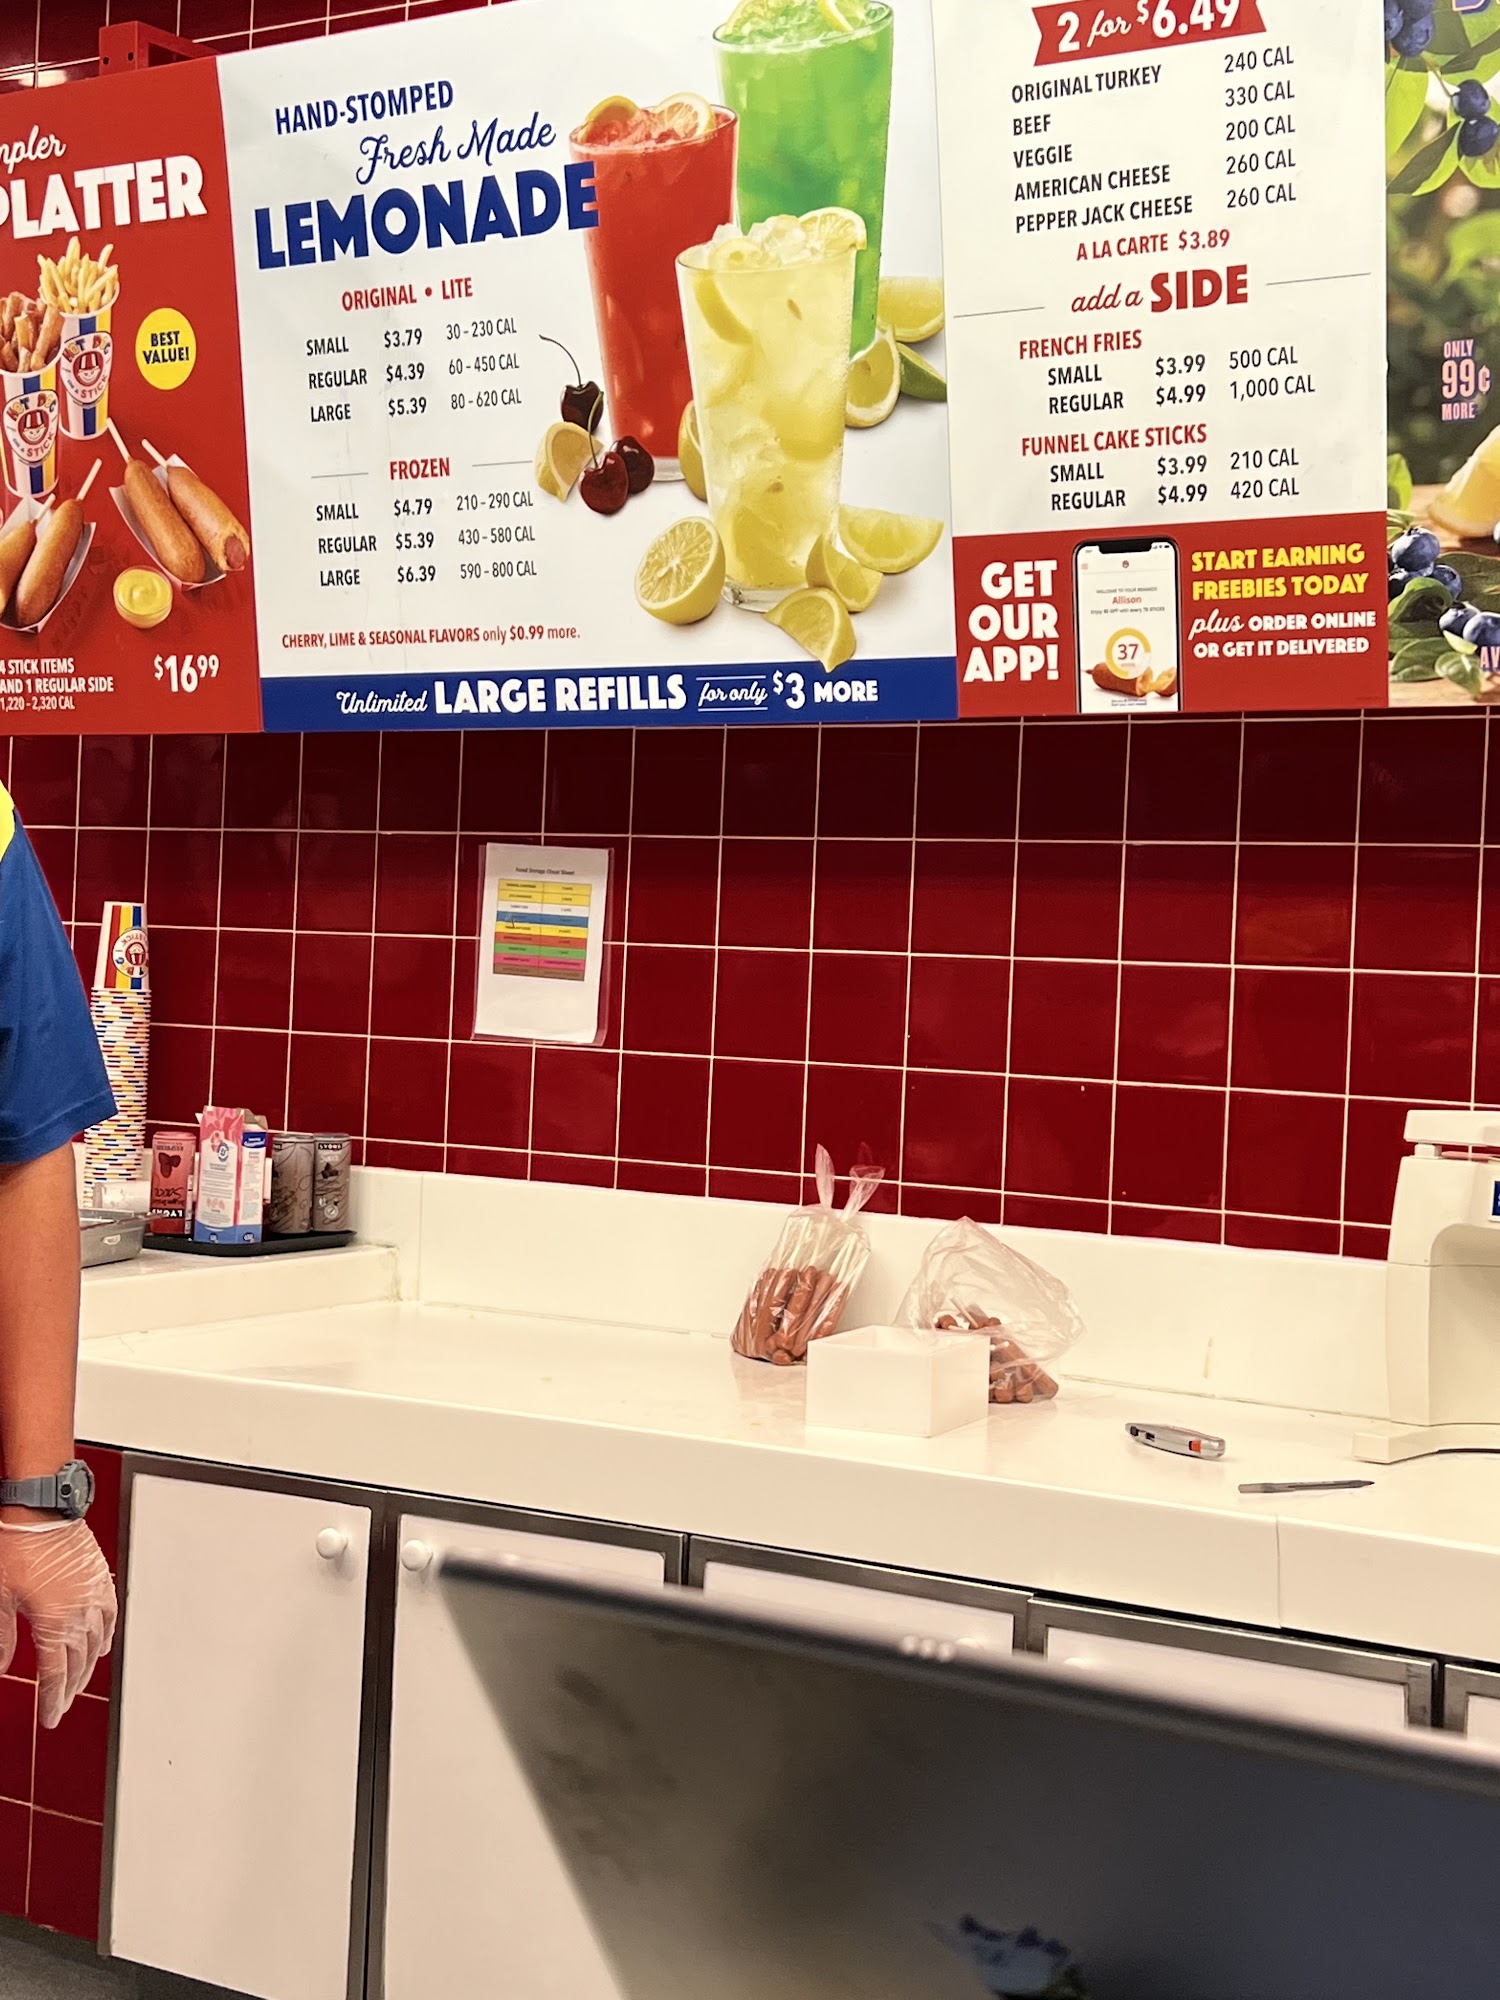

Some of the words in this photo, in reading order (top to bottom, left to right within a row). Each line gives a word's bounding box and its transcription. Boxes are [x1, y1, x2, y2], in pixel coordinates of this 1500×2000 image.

[1057, 11, 1080, 53] 2
[1087, 10, 1131, 47] for
[1137, 0, 1239, 38] $6.49
[1224, 51, 1257, 73] 240
[1263, 45, 1294, 67] CAL
[1012, 75, 1092, 103] ORIGINAL
[1095, 64, 1161, 91] TURKEY
[1225, 85, 1258, 107] 330
[1264, 80, 1295, 102] CAL
[276, 81, 453, 135] HAND-STOMPED
[1013, 114, 1051, 136] BEEF
[1226, 119, 1258, 141] 200
[1264, 114, 1295, 136] CAL
[356, 125, 451, 185] Fresh
[457, 111, 556, 166] Made
[1013, 144, 1072, 168] VEGGIE
[1226, 153, 1259, 175] 260
[1265, 149, 1296, 170] CAL
[1015, 173, 1102, 201] AMERICAN
[1108, 164, 1170, 190] CHEESE
[1227, 187, 1259, 208] 260
[1265, 183, 1296, 204] CAL
[255, 161, 599, 270] LEMONADE
[1016, 205, 1077, 233] PEPPER
[1081, 203, 1125, 226] JACK
[1130, 195, 1192, 220] CHEESE
[1076, 243, 1088, 261] A
[1093, 240, 1112, 259] LA
[1117, 233, 1168, 256] CARTE
[1179, 229, 1230, 251] $3.89
[342, 284, 417, 311] ORIGINAL
[442, 277, 473, 300] LITE
[1071, 283, 1121, 313] add
[1125, 284, 1143, 307] a
[1151, 264, 1248, 313] SIDE
[151, 330, 180, 347] BEST
[384, 328, 422, 349] $3.79
[446, 323, 461, 340] 30
[471, 320, 493, 337] 230
[496, 318, 517, 335] CAL
[142, 346, 189, 364] VALUE!
[306, 336, 349, 356] SMALL
[1020, 335, 1087, 360] FRENCH
[1094, 329, 1142, 352] FRIES
[1444, 339, 1474, 358] ONLY
[449, 358, 463, 375] 60
[474, 355, 496, 372] 450
[499, 353, 520, 370] CAL
[1155, 354, 1205, 377] $3.99
[1229, 349, 1261, 370] 500
[1267, 346, 1298, 366] CAL
[309, 368, 367, 389] REGULAR
[386, 362, 424, 383] $4.39
[1048, 364, 1102, 386] SMALL
[1442, 359, 1490, 399] 99¢
[1156, 384, 1206, 406] $4.99
[1230, 377, 1278, 401] 1,000
[1284, 375, 1315, 394] CAL
[388, 397, 427, 417] $5.39
[451, 393, 465, 410] 80
[476, 390, 498, 407] 620
[501, 389, 522, 405] CAL
[1049, 391, 1124, 414] REGULAR
[311, 404, 351, 422] LARGE
[1442, 402, 1475, 421] MORE
[1022, 433, 1089, 456] FUNNEL
[1094, 429, 1139, 451] CAKE
[1145, 423, 1207, 447] STICKS
[390, 457, 450, 480] FROZEN
[1157, 455, 1207, 476] $3.99
[1230, 450, 1262, 470] 210
[1268, 448, 1299, 467] CAL
[1050, 462, 1104, 483] SMALL
[1158, 484, 1207, 505] $4.99
[1231, 480, 1263, 499] 420
[1269, 477, 1299, 497] CAL
[394, 498, 432, 517] $4.79
[456, 494, 478, 511] 210
[488, 492, 510, 509] 290
[513, 491, 533, 507] CAL
[1052, 490, 1125, 511] REGULAR
[316, 503, 359, 521] SMALL
[318, 535, 377, 554] REGULAR
[396, 532, 434, 550] $5.39
[458, 528, 480, 545] 430
[491, 527, 512, 543] 580
[514, 526, 535, 542] CAL
[1192, 549, 1257, 572] START
[1262, 543, 1365, 568] EARNING
[320, 569, 360, 587] LARGE
[397, 565, 436, 583] $6.39
[460, 563, 481, 579] 590
[492, 561, 513, 578] 800
[516, 560, 537, 577] CAL
[981, 560, 1057, 599] GET
[1193, 577, 1287, 600] FREEBIES
[1291, 573, 1369, 596] TODAY
[1112, 596, 1142, 604] Allison
[968, 603, 1059, 641] OUR
[1188, 609, 1244, 640] plus
[1248, 614, 1308, 631] ORDER
[1311, 611, 1376, 629] ONLINE
[282, 633, 327, 648] CHERRY,
[329, 632, 356, 646] LIME
[358, 631, 366, 646] &
[369, 629, 427, 645] SEASONAL
[429, 627, 480, 643] FLAVORS
[483, 626, 507, 645] only
[510, 625, 544, 641] $0.99
[547, 627, 580, 639] more.
[1193, 643, 1219, 658] OR
[1222, 641, 1255, 657] GET
[1258, 640, 1273, 656] IT
[1277, 637, 1369, 655] DELIVERED
[1118, 643, 1139, 660] 37
[8, 659, 39, 675] STICK
[41, 658, 74, 674] ITEMS
[963, 644, 1059, 682] APP!
[0, 678, 23, 694] AND
[25, 678, 32, 693] 1
[35, 677, 86, 693] REGULAR
[88, 676, 114, 692] SIDE
[336, 690, 428, 714] Unlimited
[434, 679, 546, 714] LARGE
[555, 674, 686, 711] REFILLS
[698, 683, 727, 706] for
[729, 681, 768, 705] only
[773, 670, 805, 709] $3
[814, 680, 878, 703] MORE
[0, 696, 25, 712] 1,220
[32, 696, 57, 711] 2,320
[58, 695, 75, 709] CAL
